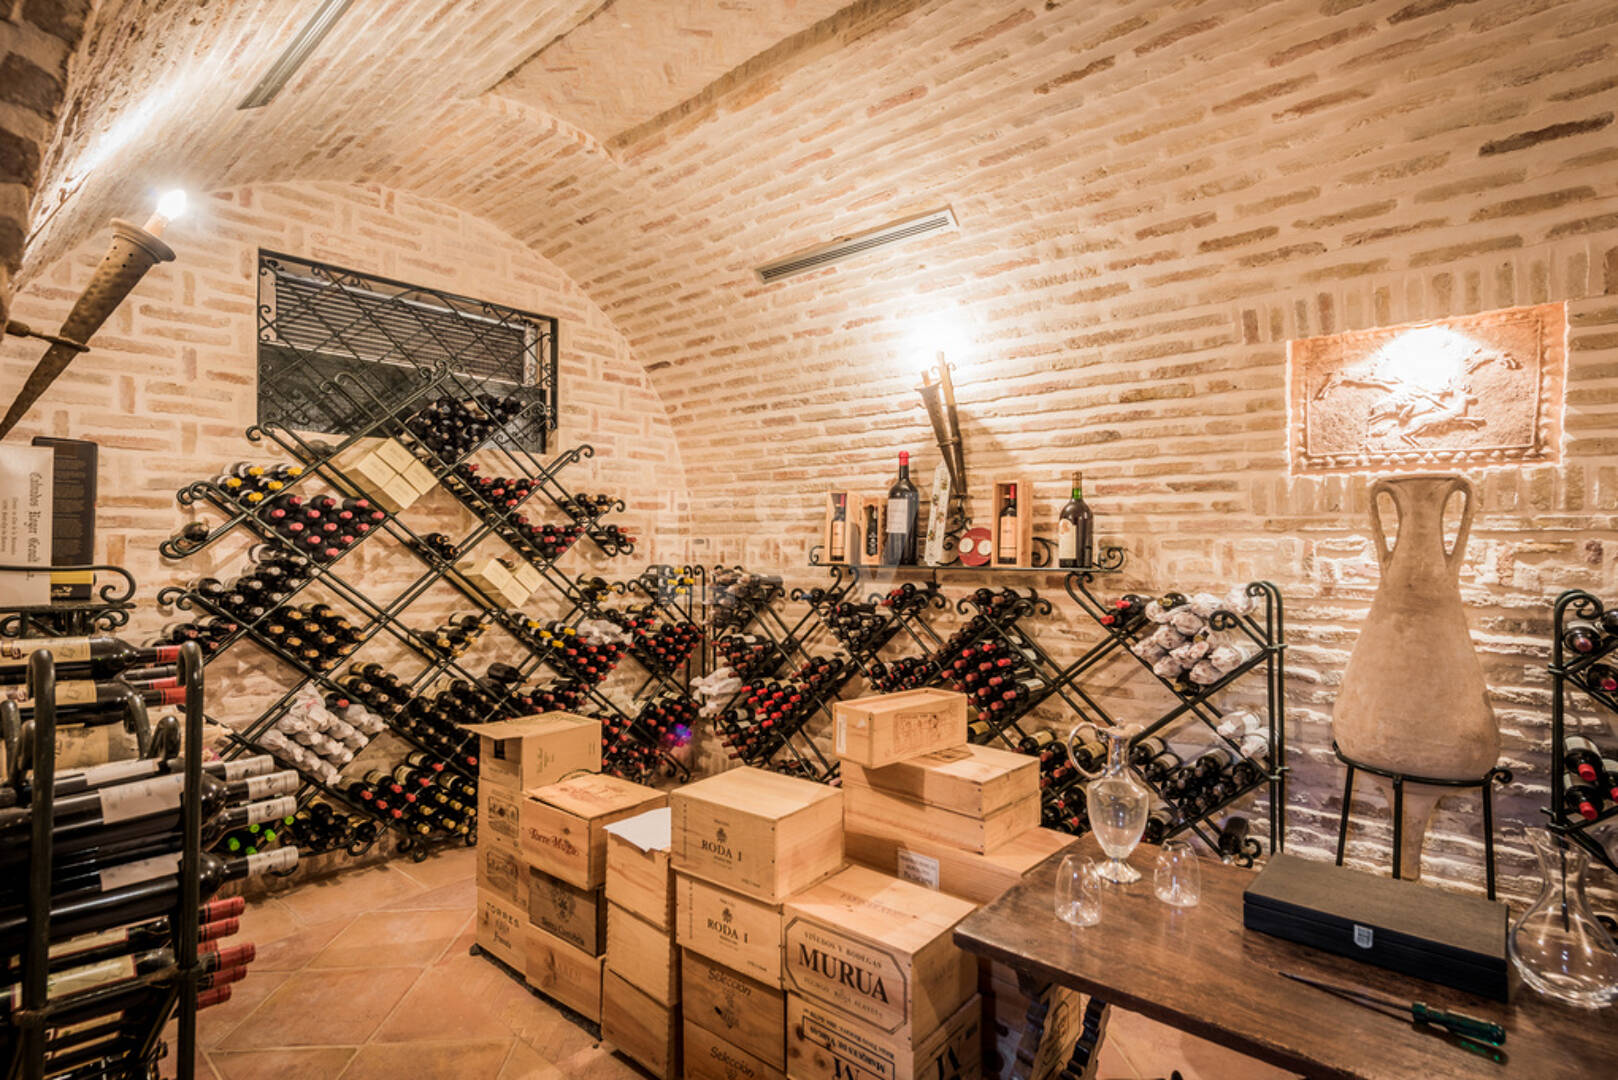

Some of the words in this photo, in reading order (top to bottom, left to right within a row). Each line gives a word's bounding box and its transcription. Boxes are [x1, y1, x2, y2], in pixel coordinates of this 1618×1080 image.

[702, 839, 733, 859] RODA
[707, 918, 739, 940] RODA
[799, 943, 889, 1004] MURUA
